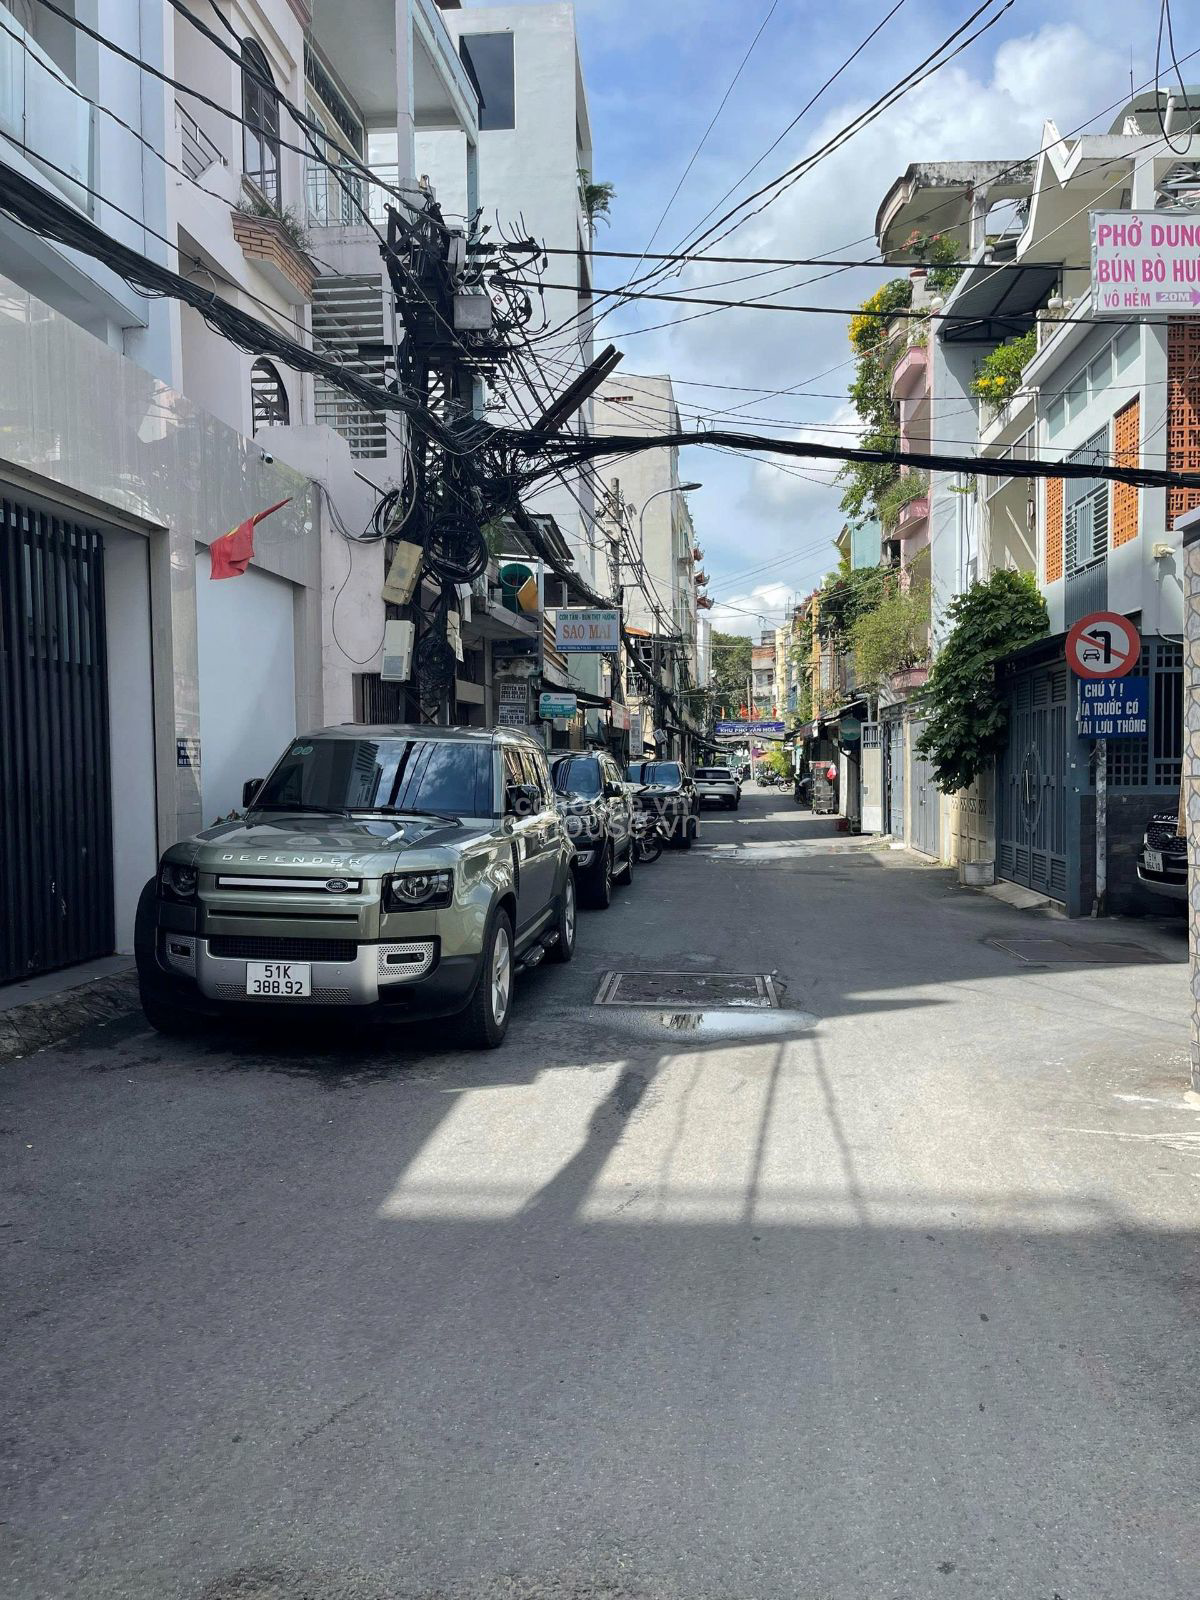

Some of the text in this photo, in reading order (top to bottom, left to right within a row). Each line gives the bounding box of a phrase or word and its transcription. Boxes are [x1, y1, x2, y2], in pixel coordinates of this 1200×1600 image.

[1098, 215, 1143, 247] PHỞ
[1098, 252, 1136, 283] BÚN
[1142, 252, 1166, 283] BÒ
[1104, 287, 1190, 307] VÔ HẺM 20M
[562, 624, 612, 639] SAO MAI
[1084, 680, 1105, 698] CHÚ
[1109, 680, 1116, 697] Ý
[1081, 698, 1139, 716] ÍA TRƯỚC CÓ
[1116, 716, 1147, 733] THÔNG
[222, 854, 361, 866] DEFENDER
[264, 965, 292, 979] 51K
[253, 980, 303, 995] 388.92
